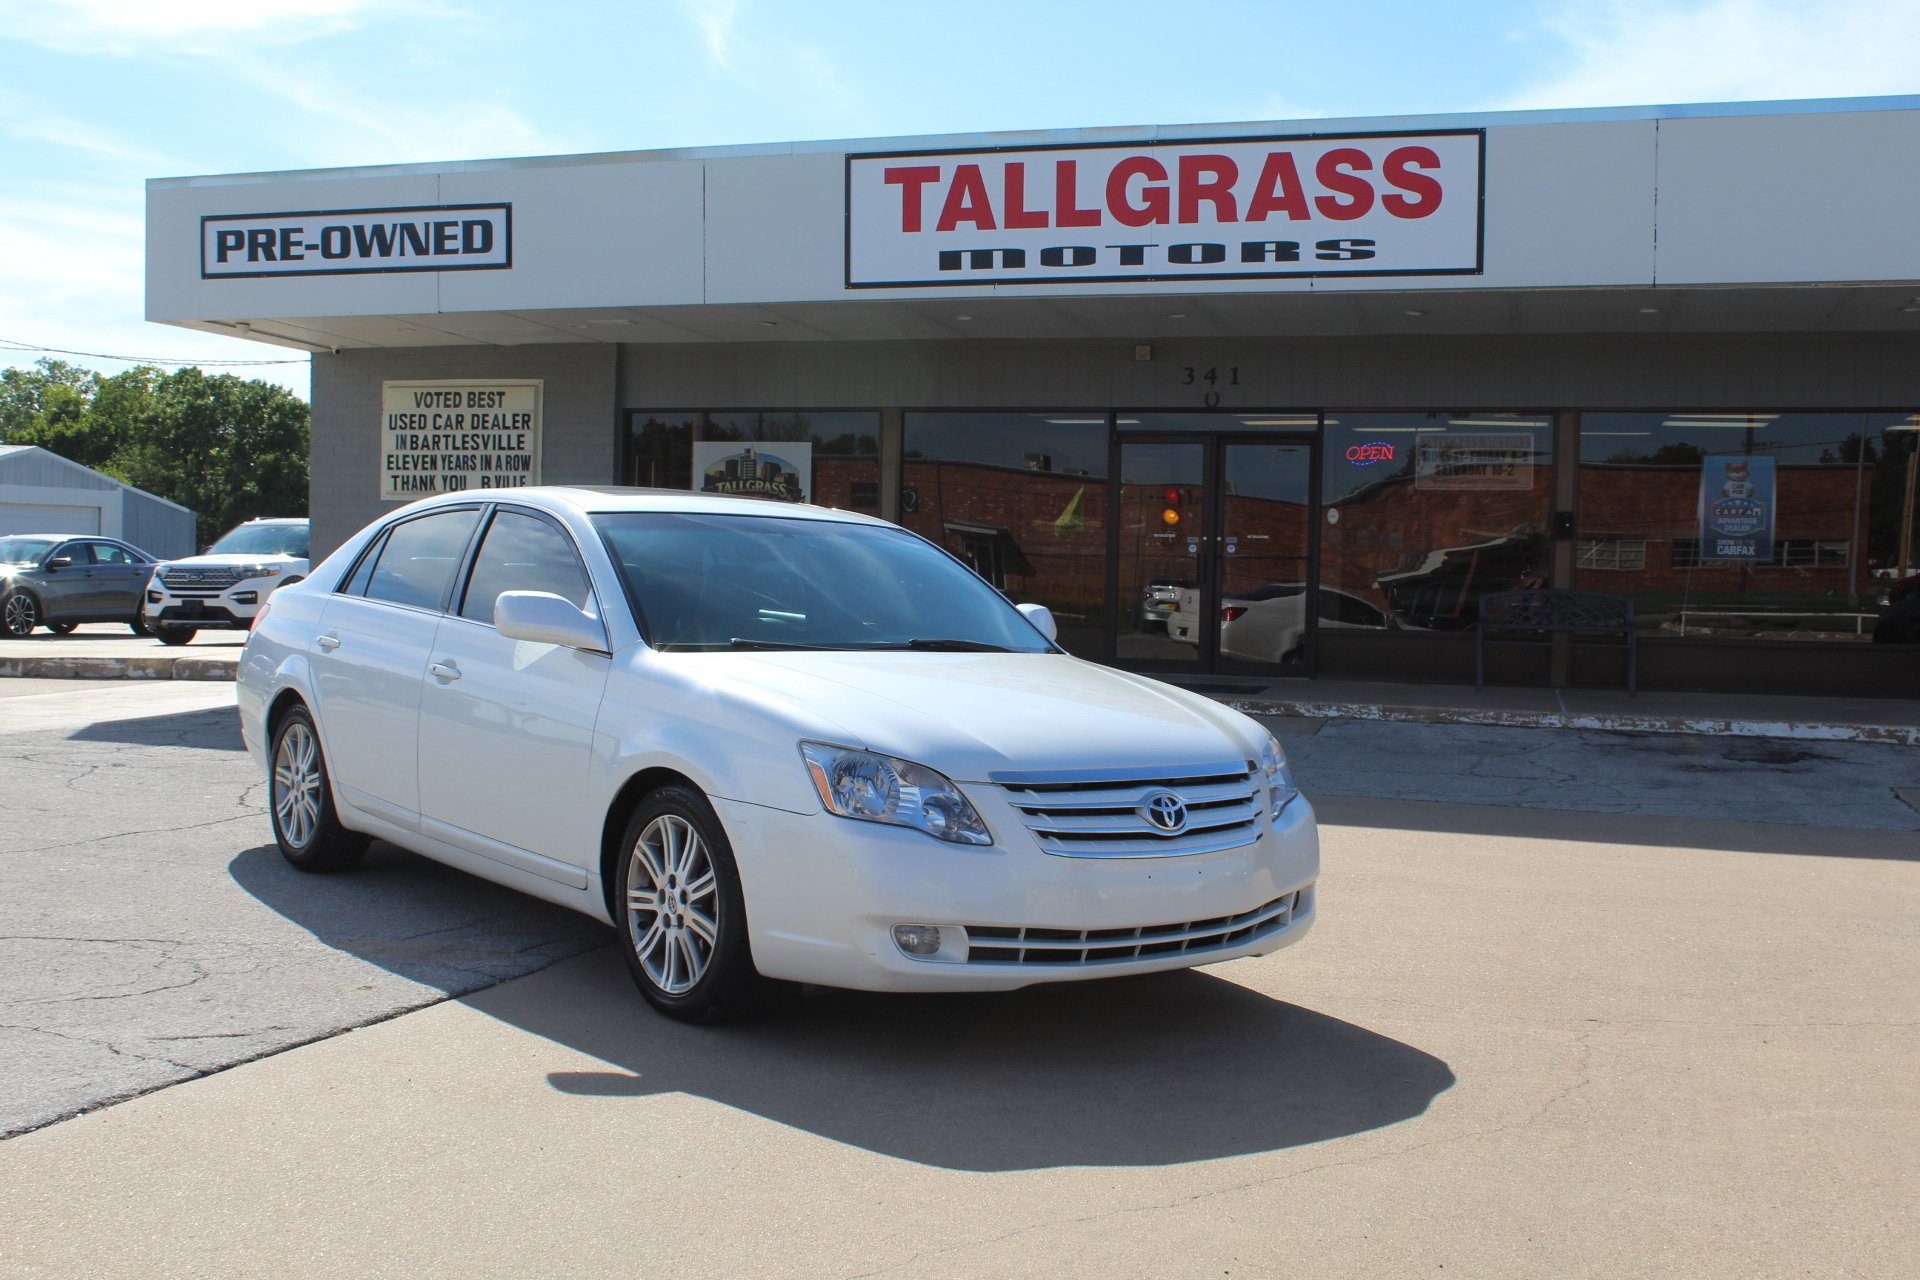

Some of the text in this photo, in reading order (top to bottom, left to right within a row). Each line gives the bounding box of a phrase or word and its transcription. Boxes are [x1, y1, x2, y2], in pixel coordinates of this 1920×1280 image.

[884, 146, 1444, 232] TALLGRASS
[216, 219, 494, 263] PRE-OWNED
[938, 238, 1377, 271] MOTORS
[414, 391, 506, 409] VOTED BEST
[389, 413, 531, 431] USED CAR DEALER
[396, 434, 525, 451] IN BARTLESVILLE
[1346, 446, 1395, 461] OPEN
[387, 454, 531, 471] ELEVEN YEARS IN A ROW
[391, 475, 436, 491] THANK
[442, 475, 467, 491] YOU
[716, 480, 787, 497] TALLGRASS
[1717, 545, 1755, 555] CARFAX
